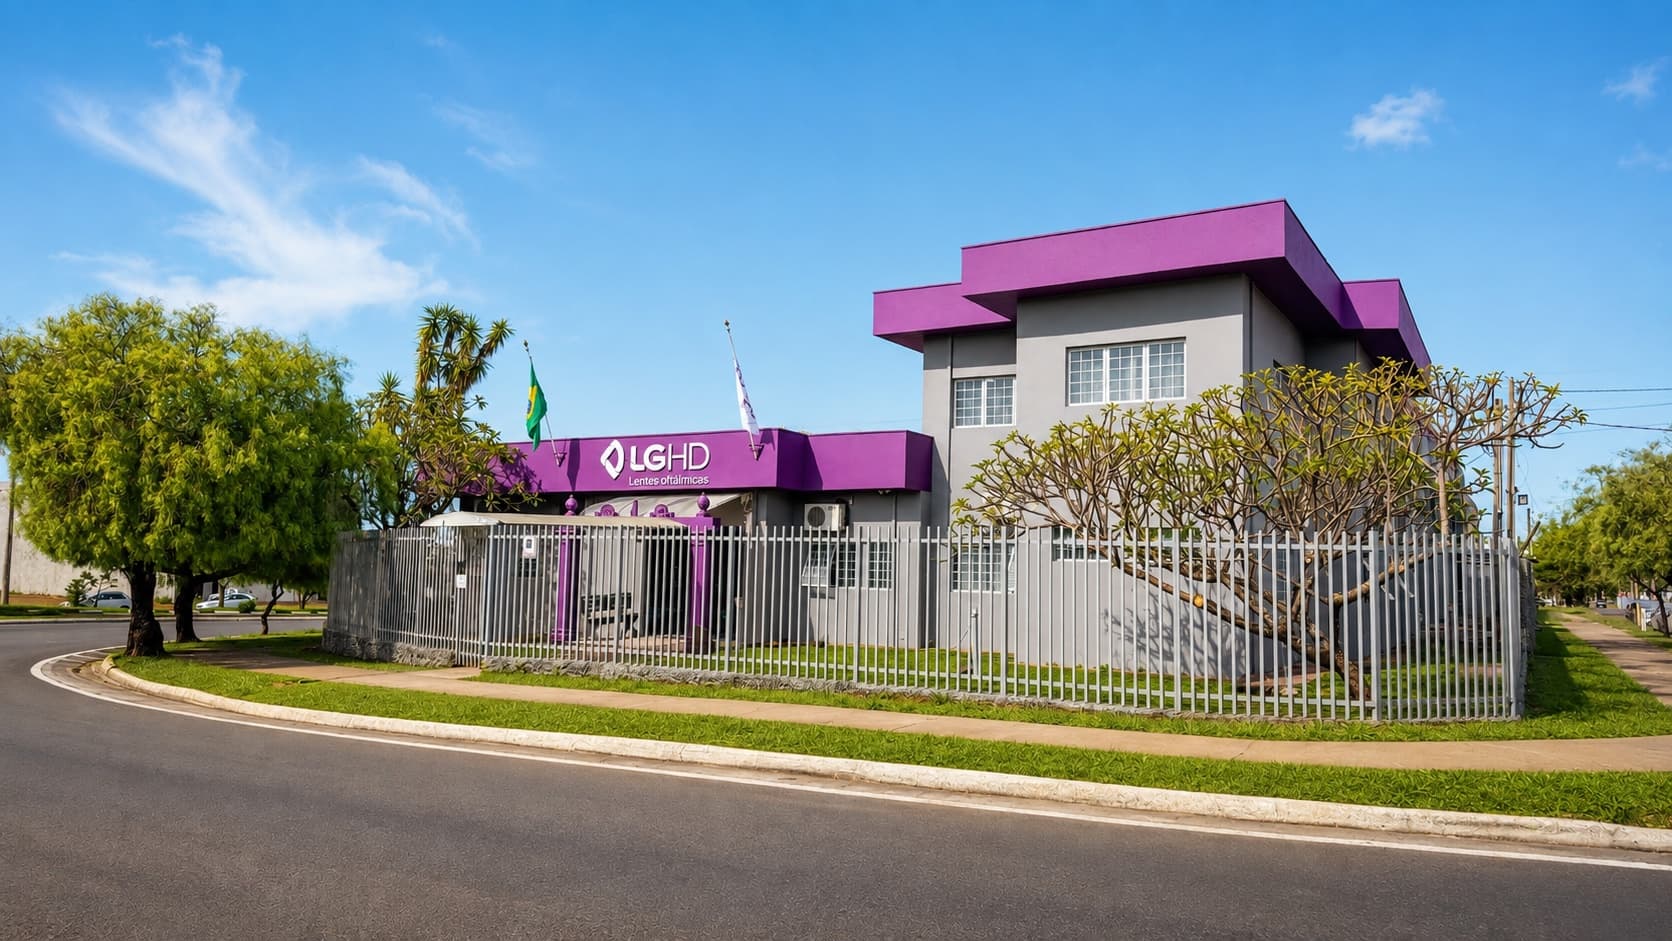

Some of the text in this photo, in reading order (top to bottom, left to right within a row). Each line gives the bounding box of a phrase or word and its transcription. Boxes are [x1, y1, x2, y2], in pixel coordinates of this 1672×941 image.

[630, 442, 710, 471] LGHD
[628, 474, 710, 486] Lentes oftálmicas
